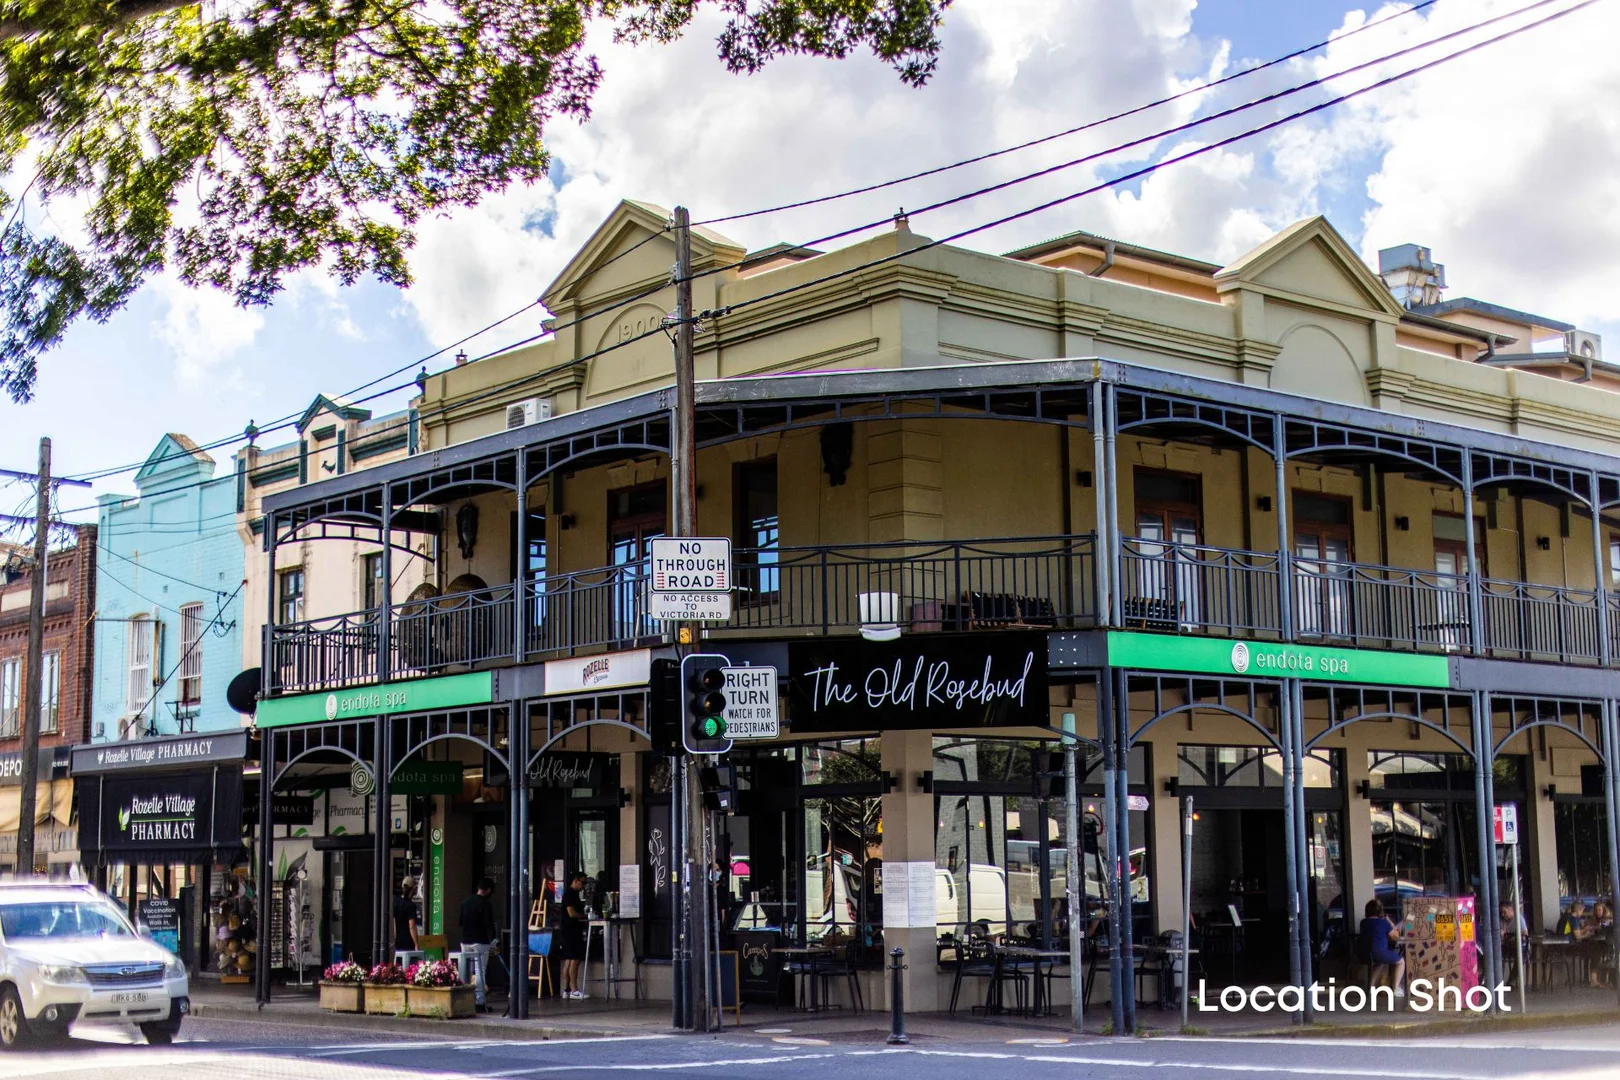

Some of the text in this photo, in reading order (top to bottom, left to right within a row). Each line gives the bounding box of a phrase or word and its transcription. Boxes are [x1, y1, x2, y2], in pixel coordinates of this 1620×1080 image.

[679, 542, 701, 555] NO
[656, 559, 726, 571] THROUGH
[668, 575, 714, 588] ROAD
[663, 594, 677, 602] NO
[685, 603, 697, 611] TO
[708, 611, 722, 619] RD
[1256, 650, 1348, 675] endota spa
[583, 658, 610, 685] ROZELLE
[726, 673, 770, 689] RIGHT
[804, 651, 1034, 712] The Old Rosebud
[341, 692, 406, 712] endota spa
[729, 690, 769, 705] TURN
[728, 708, 771, 719] WATCH FOR
[726, 722, 775, 733] PEDESTRIANS
[105, 741, 213, 764] Rozelle Village PHARMACY
[530, 756, 594, 783] Old Rosebud
[432, 772, 456, 784] spa
[131, 795, 196, 816] Rozelle Village
[131, 822, 195, 840] PHARMACY
[432, 856, 441, 914] endota
[1436, 914, 1453, 923] 0659
